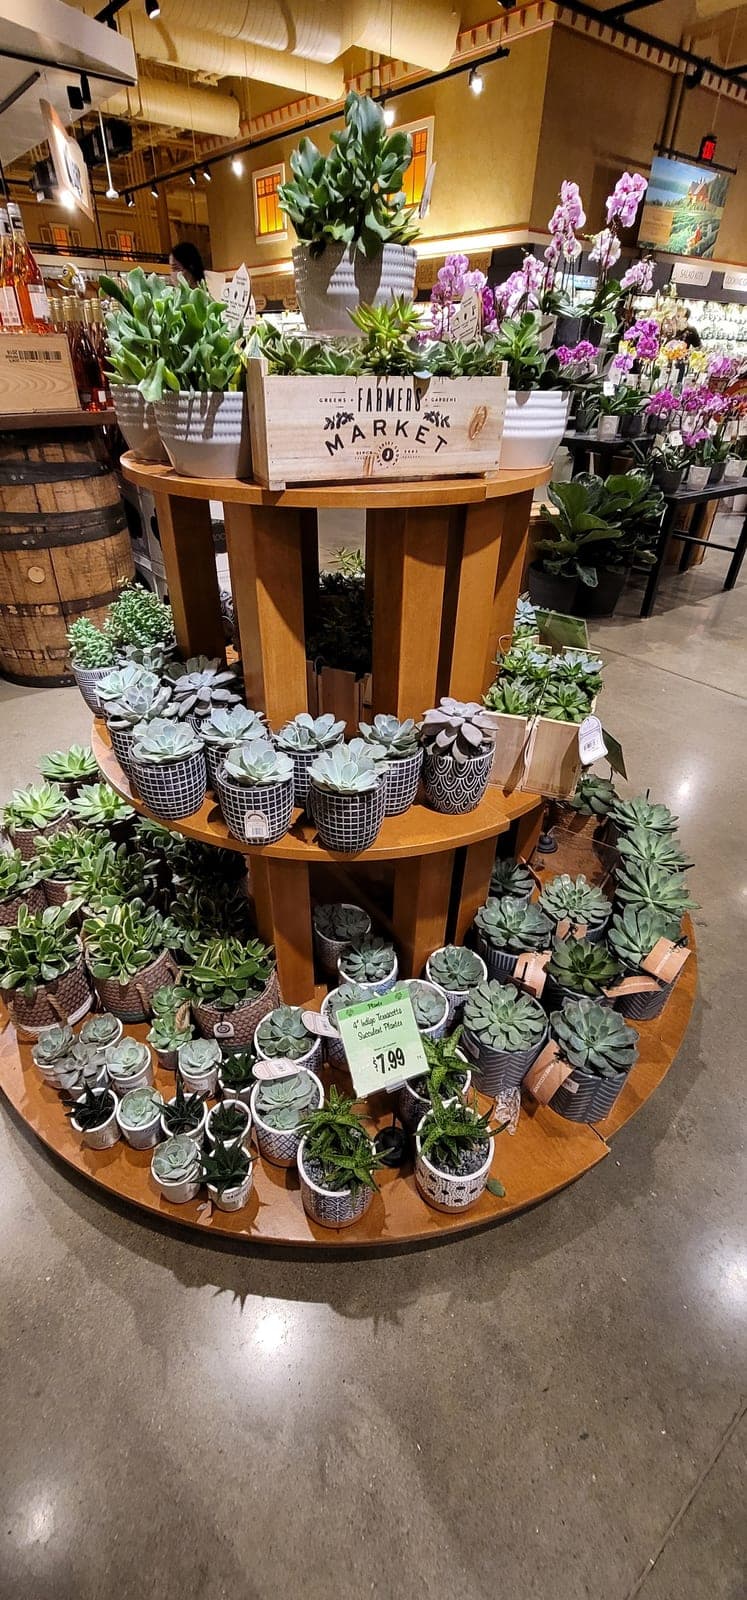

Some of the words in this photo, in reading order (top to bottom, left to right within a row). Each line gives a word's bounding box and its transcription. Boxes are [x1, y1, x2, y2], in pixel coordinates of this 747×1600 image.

[358, 388, 422, 412] FARMERS
[324, 419, 448, 456] MARKET
[358, 1026, 383, 1040] Succulent
[361, 1017, 376, 1027] Indigo
[372, 1047, 405, 1074] $7.99
